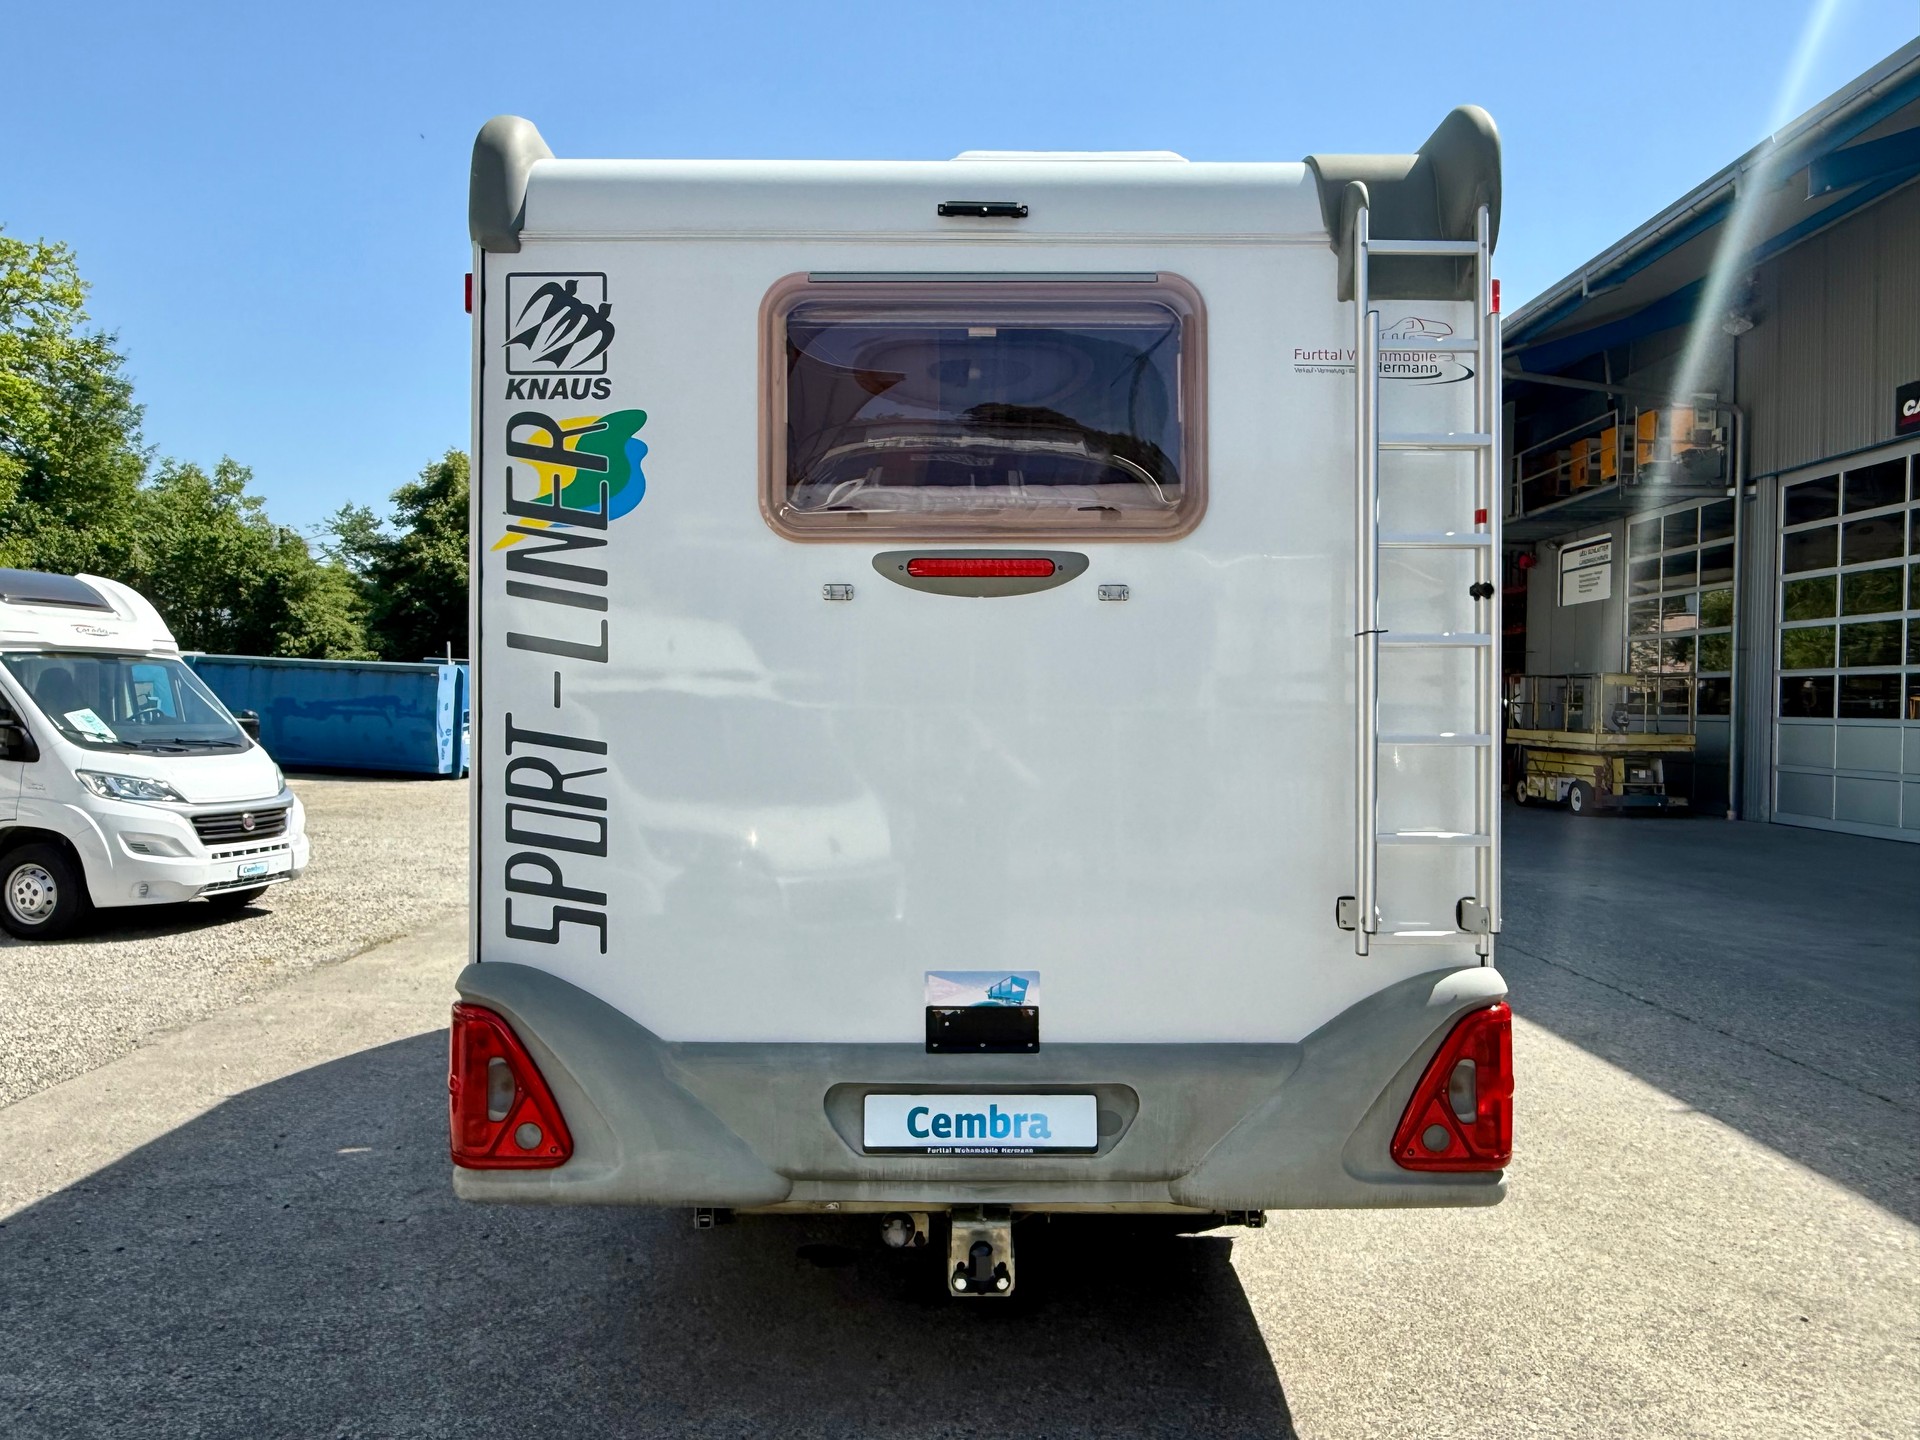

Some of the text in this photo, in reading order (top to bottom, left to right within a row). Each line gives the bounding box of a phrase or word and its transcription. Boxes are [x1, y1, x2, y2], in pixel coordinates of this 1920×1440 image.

[1294, 348, 1343, 361] Furttal
[505, 377, 612, 400] KNAUS
[906, 1104, 1051, 1139] Cembra
